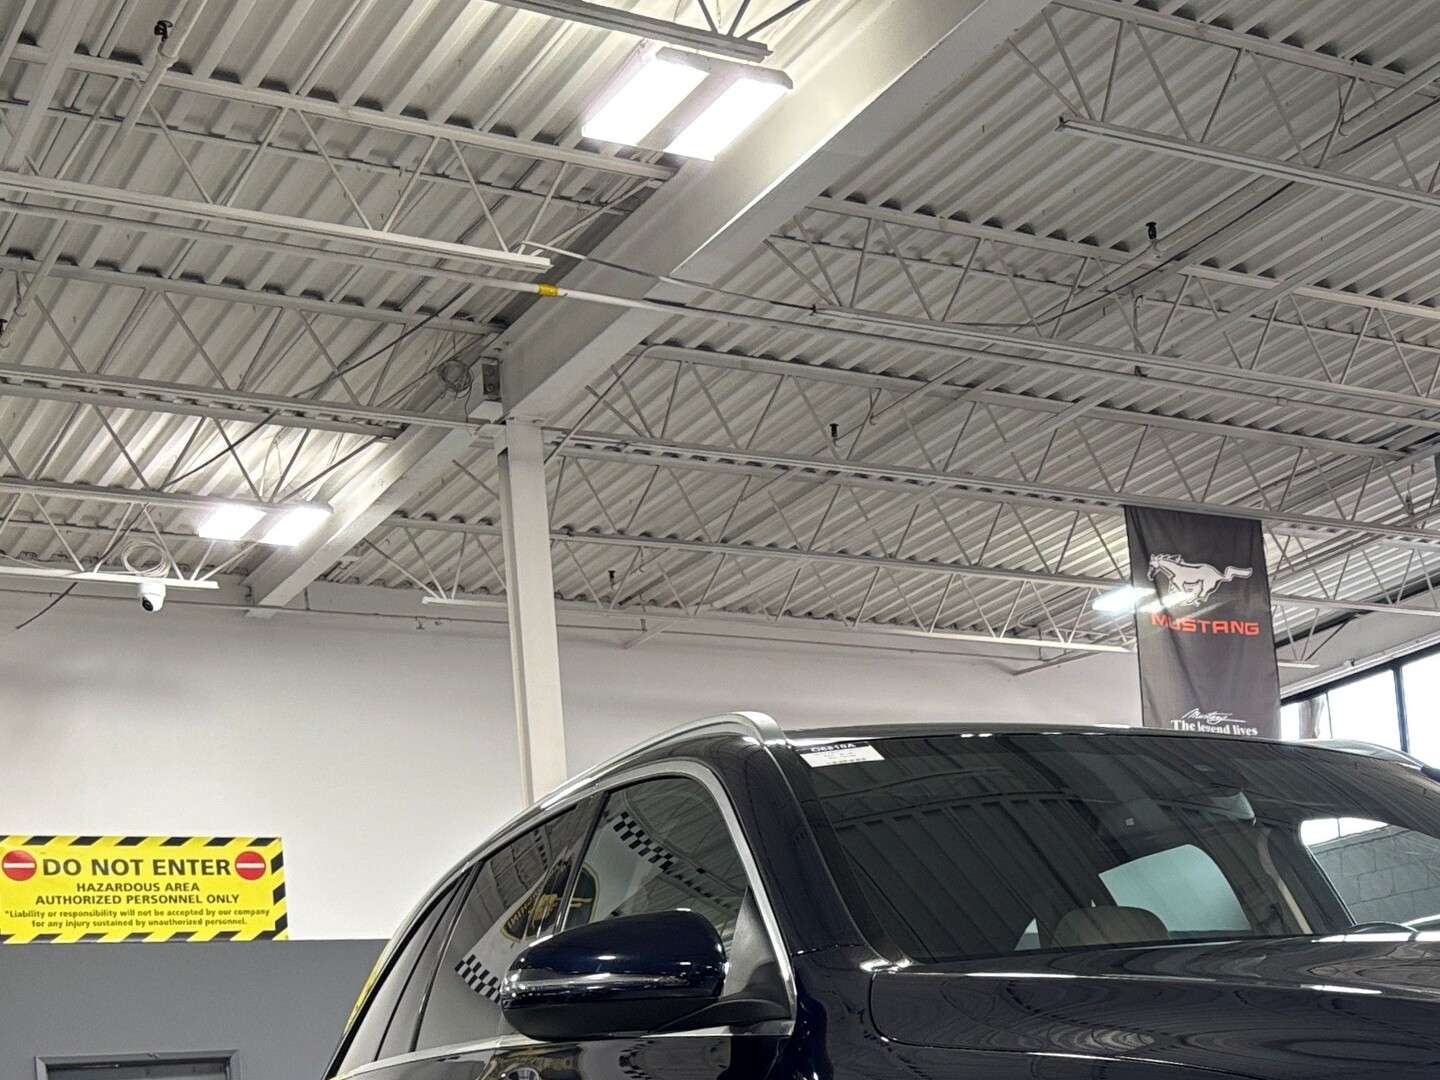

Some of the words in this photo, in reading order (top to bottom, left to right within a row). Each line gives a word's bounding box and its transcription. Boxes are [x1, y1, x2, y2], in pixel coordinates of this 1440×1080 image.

[1151, 612, 1260, 635] MUSTANG
[1171, 719, 1195, 731] The
[1197, 721, 1230, 734] legend
[1232, 724, 1258, 736] lives
[43, 859, 82, 876] DO
[92, 858, 143, 876] NOT
[153, 858, 231, 876] ENTER
[77, 882, 160, 892] HAZARDOUS
[164, 882, 200, 892] AREA
[35, 895, 121, 905] AUTHORIZED
[127, 894, 202, 904] PERSONNEL
[207, 894, 240, 904] ONLY
[60, 910, 117, 918] responsibility
[167, 908, 204, 917] accepted
[206, 908, 216, 917] by
[234, 909, 270, 917] company
[66, 920, 90, 928] injury
[93, 919, 133, 927] sustained
[136, 919, 146, 928] by
[148, 918, 202, 926] unauthorized
